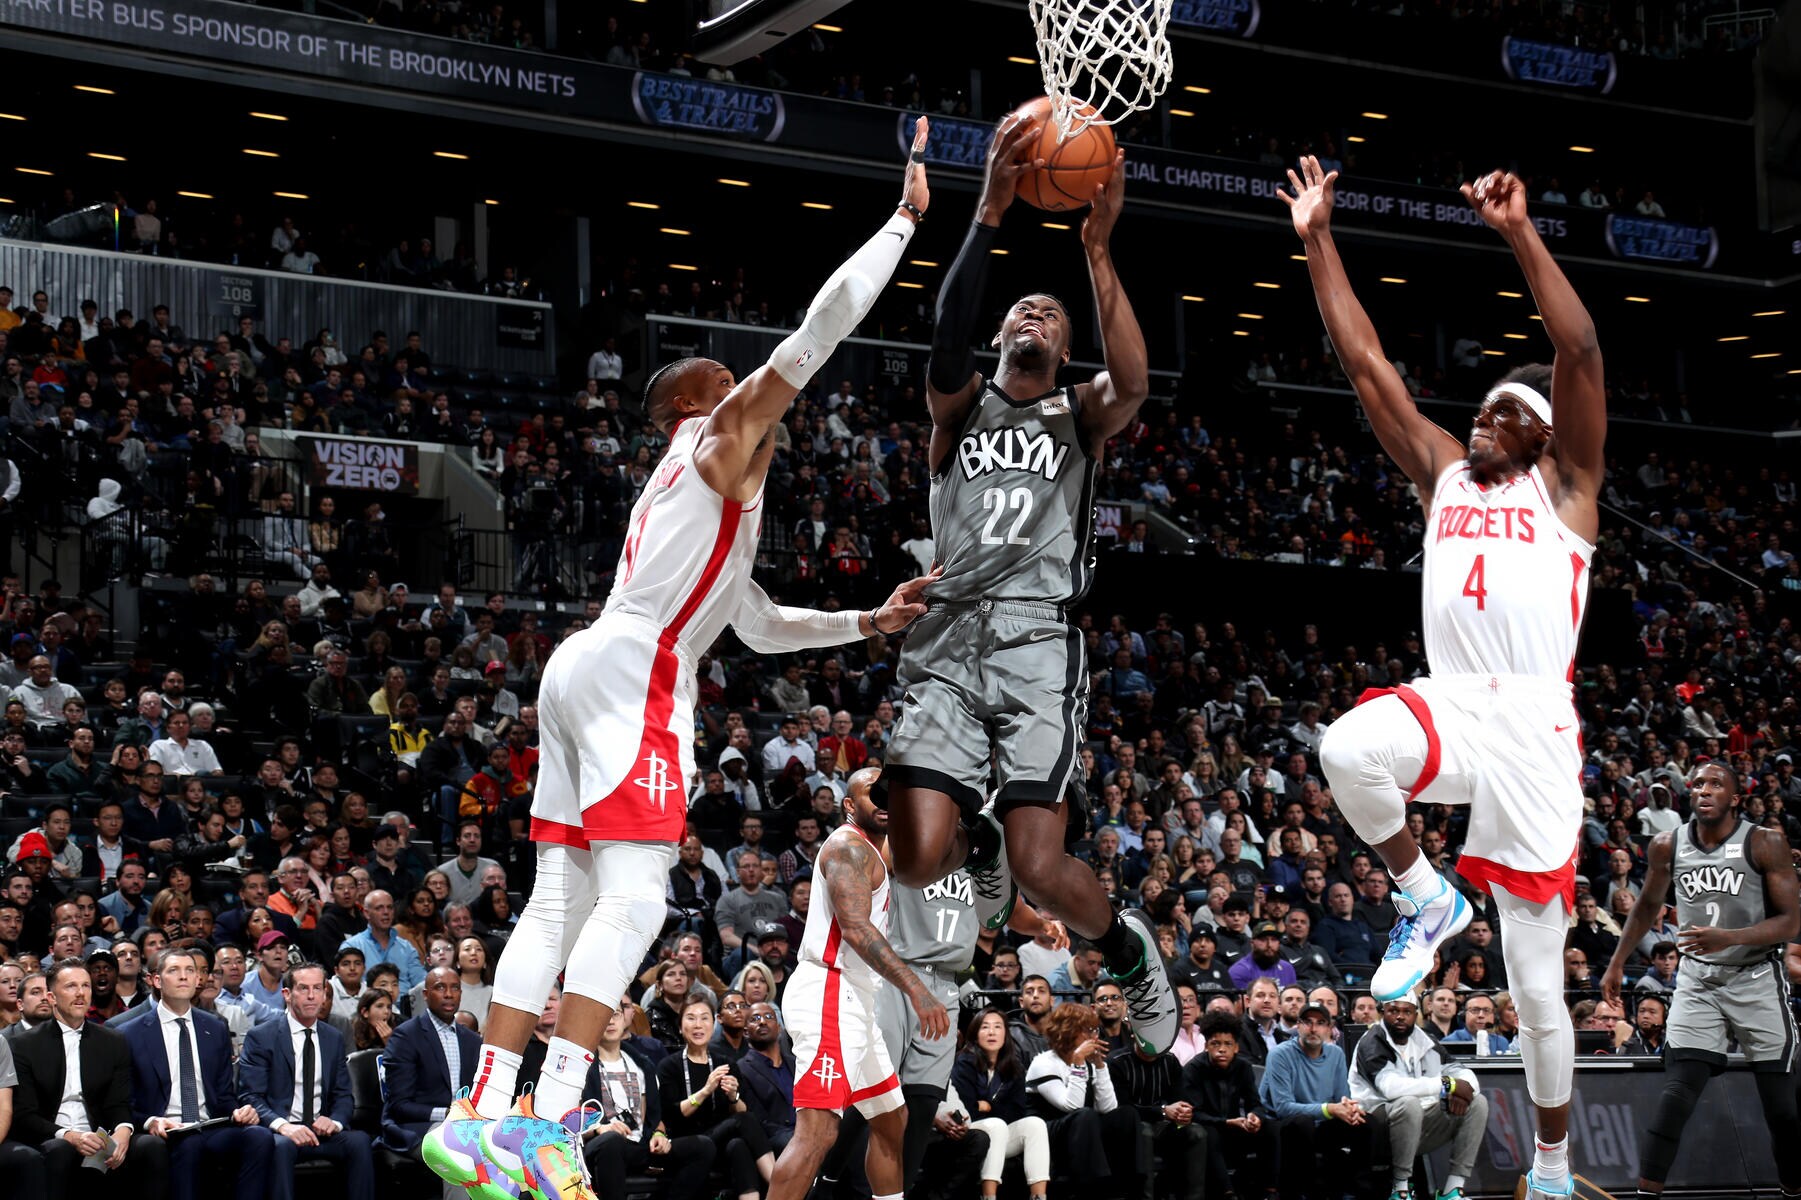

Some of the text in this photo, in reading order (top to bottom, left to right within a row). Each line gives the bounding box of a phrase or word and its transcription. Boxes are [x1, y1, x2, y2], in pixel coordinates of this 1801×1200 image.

[113, 4, 165, 31] BUS
[172, 13, 291, 52] SPONSOR
[298, 34, 328, 58] OF
[334, 40, 382, 67] THE
[389, 48, 511, 88] BROOKLYN
[517, 69, 577, 97] NETS
[1508, 40, 1552, 61] BEST
[1535, 61, 1597, 86] TRAVEL
[641, 77, 774, 115] BEST TRAILS
[655, 100, 760, 132] & TRAVEL
[1123, 160, 1161, 184] CIAL
[1164, 165, 1248, 195] CHARTER
[1372, 194, 1395, 215] OF
[1400, 198, 1431, 220] THE
[221, 285, 252, 302] 108
[884, 358, 908, 374] 109
[314, 440, 405, 469] VISION
[958, 426, 1070, 483] BKLYN
[325, 464, 400, 491] ZERO
[981, 487, 1034, 546] 22
[1463, 554, 1487, 612] 4
[1679, 865, 1745, 899] BKLYN
[936, 908, 960, 943] 17
